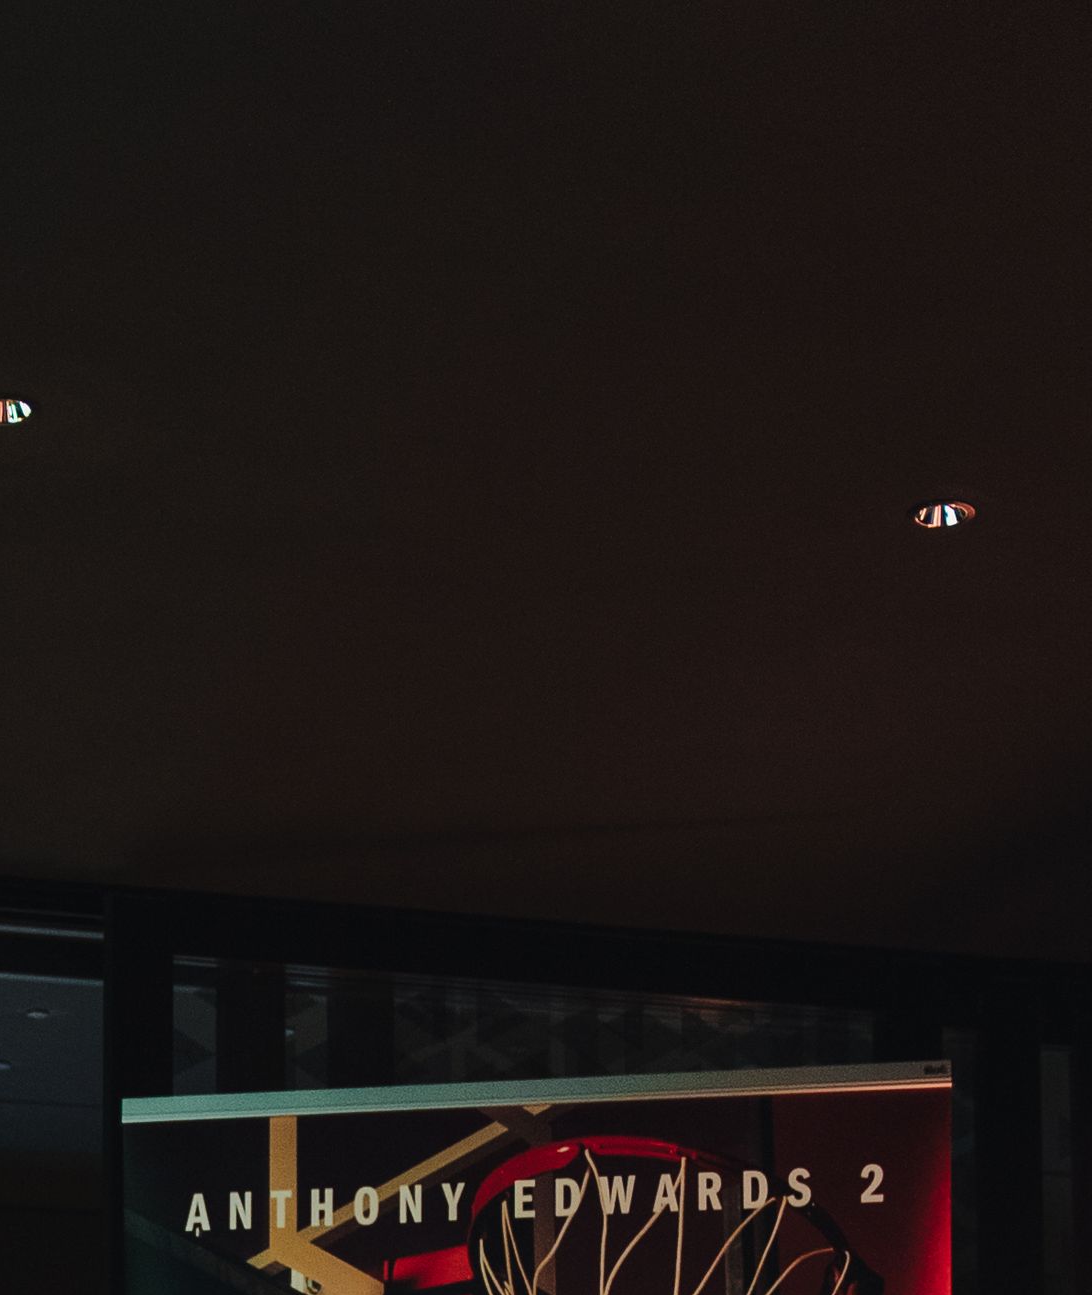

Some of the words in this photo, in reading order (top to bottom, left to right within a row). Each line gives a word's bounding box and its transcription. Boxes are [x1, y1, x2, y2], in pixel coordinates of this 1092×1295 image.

[184, 1182, 466, 1233] ANTHONY
[513, 1167, 812, 1219] EDWARDS
[859, 1163, 885, 1204] 2
